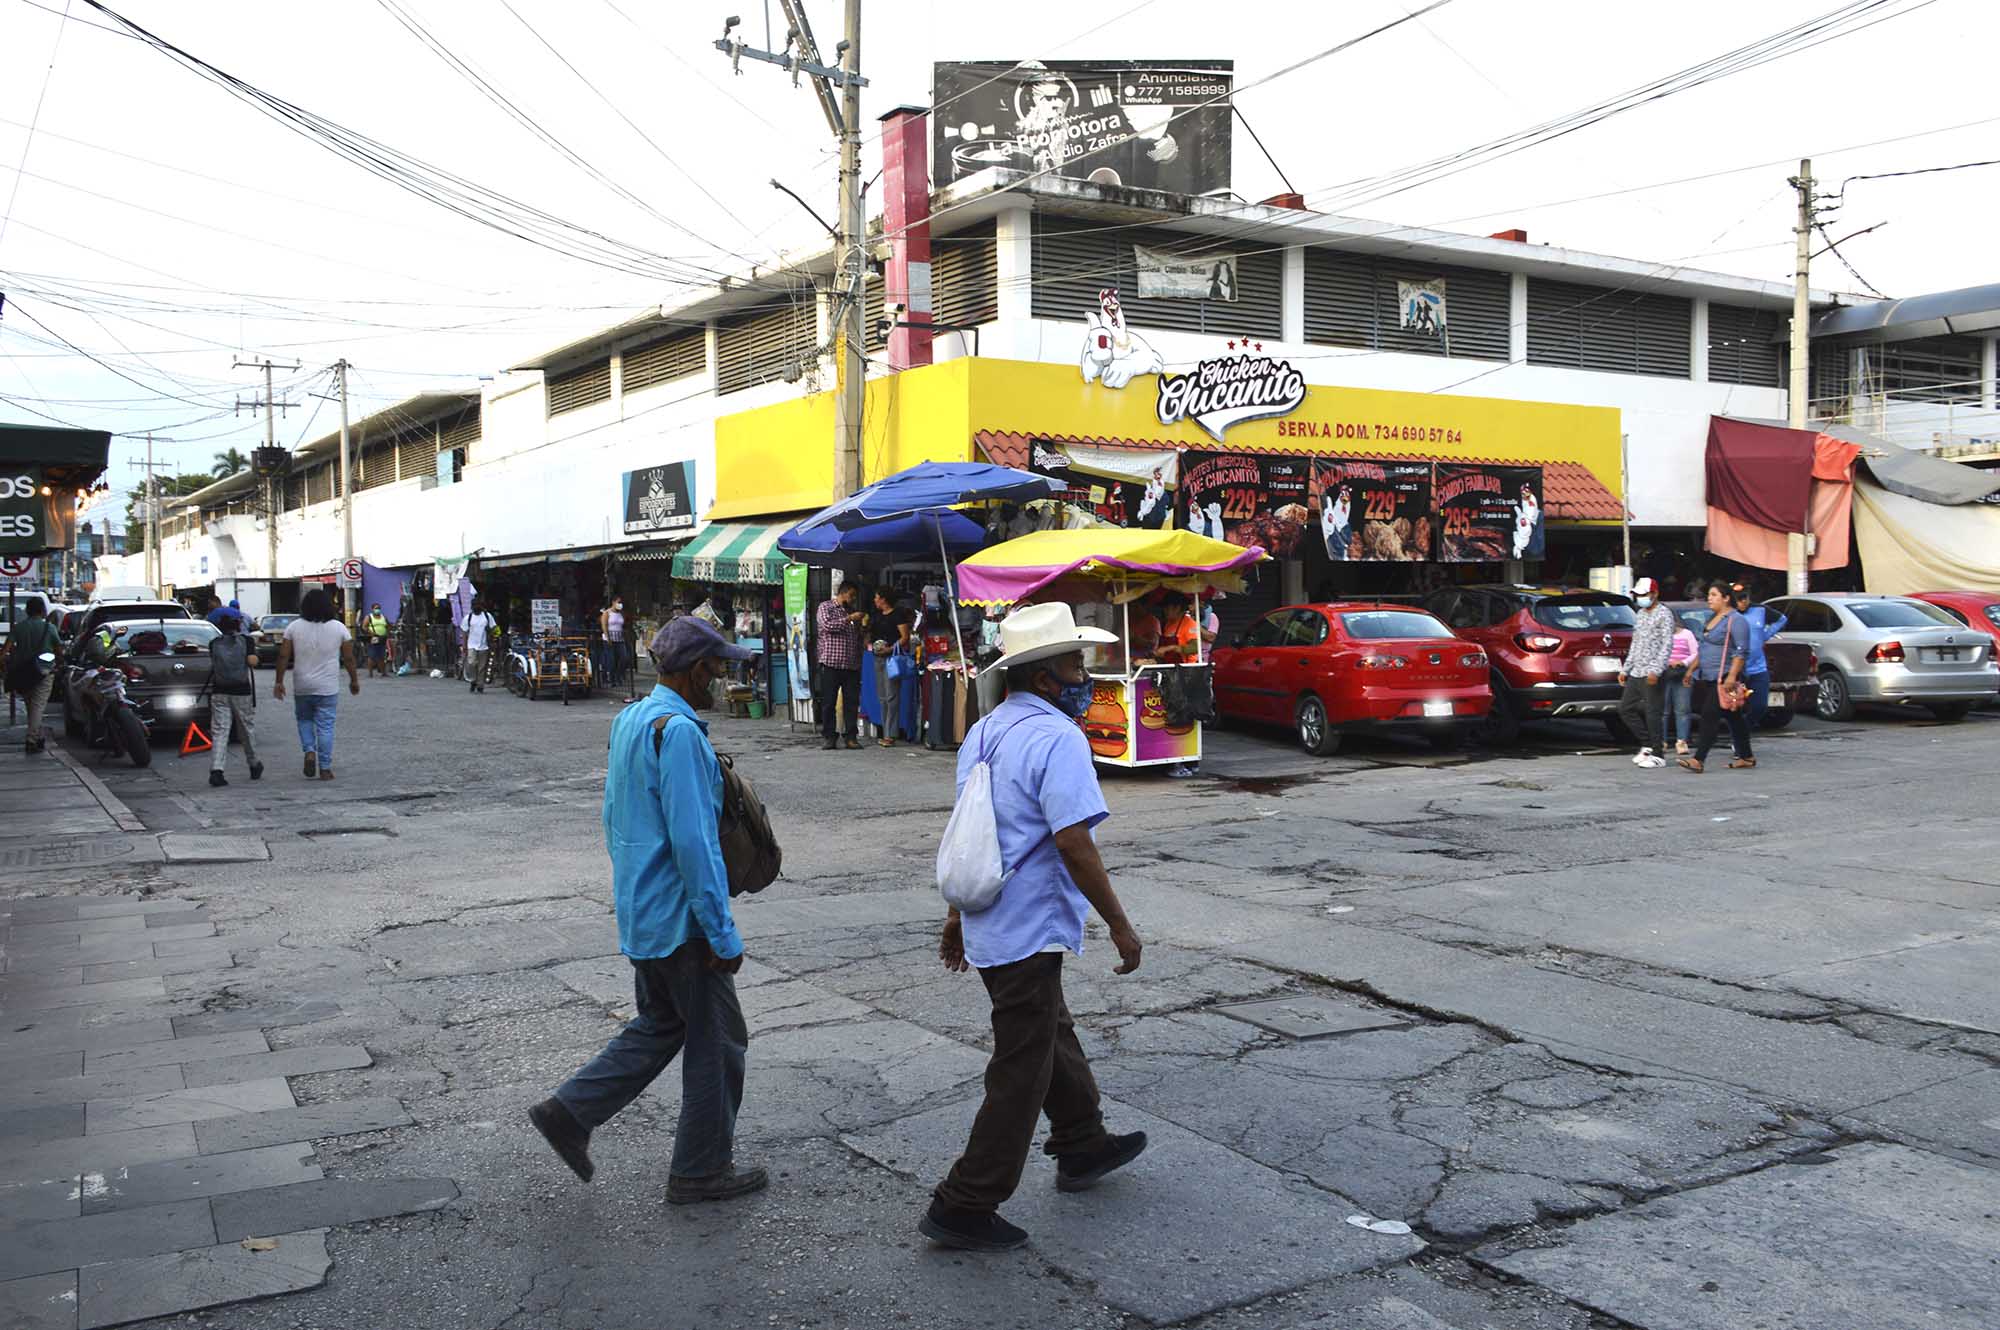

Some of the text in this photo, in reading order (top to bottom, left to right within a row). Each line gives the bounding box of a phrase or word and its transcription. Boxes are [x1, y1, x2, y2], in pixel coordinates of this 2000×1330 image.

[1138, 85, 1227, 96] 777 1585999
[1200, 356, 1273, 388] Chicken
[1160, 363, 1304, 421] Chicanito
[1322, 422, 1331, 438] A
[1336, 423, 1370, 440] DOM.
[1375, 425, 1399, 440] 734
[1402, 426, 1425, 441] 690
[1429, 427, 1444, 442] 57
[1446, 429, 1462, 444] 64
[0, 476, 35, 498] OS
[0, 515, 35, 536] ES
